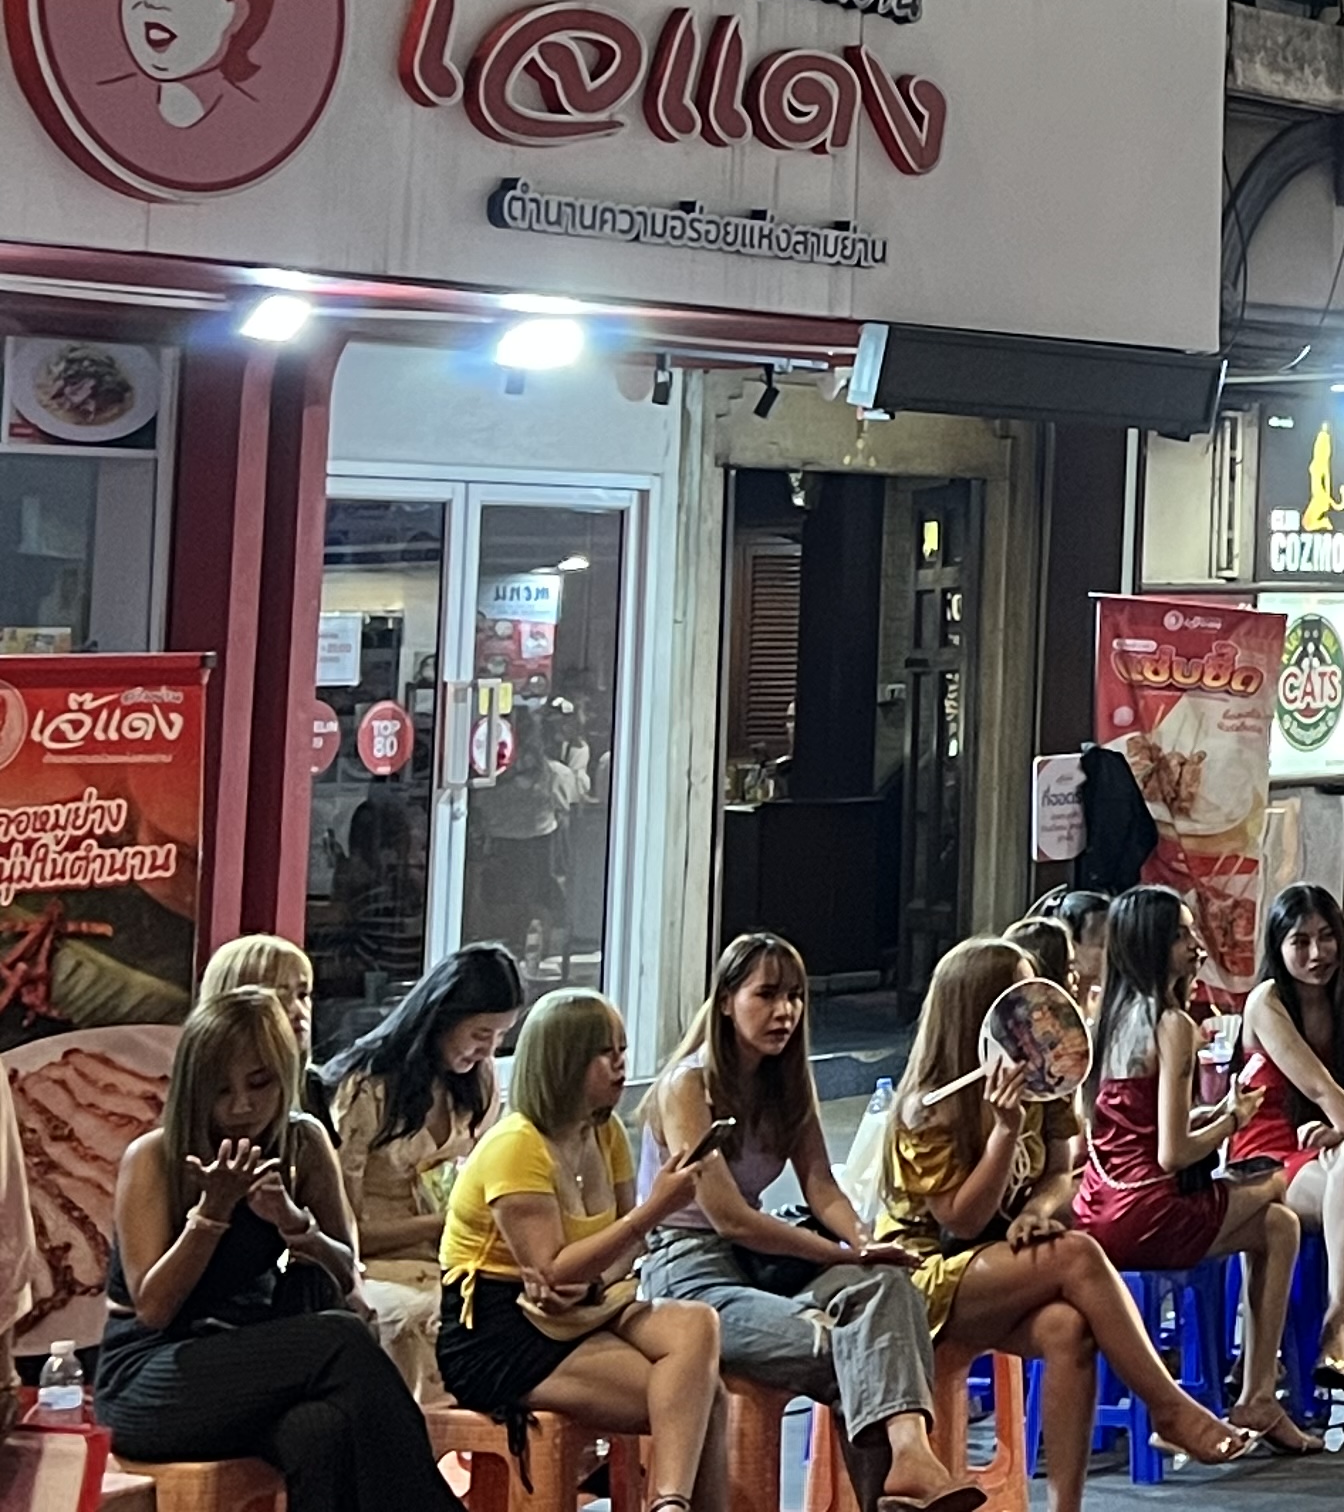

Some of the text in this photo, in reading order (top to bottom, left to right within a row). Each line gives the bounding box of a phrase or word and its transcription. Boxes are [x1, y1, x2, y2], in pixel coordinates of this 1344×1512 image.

[500, 179, 889, 268] ตำนานความอร่อยแห่งสามย่าน
[1282, 669, 1339, 705] CATS
[31, 692, 184, 750] เจ๊แดง
[371, 720, 401, 736] TOP
[373, 736, 399, 758] 80
